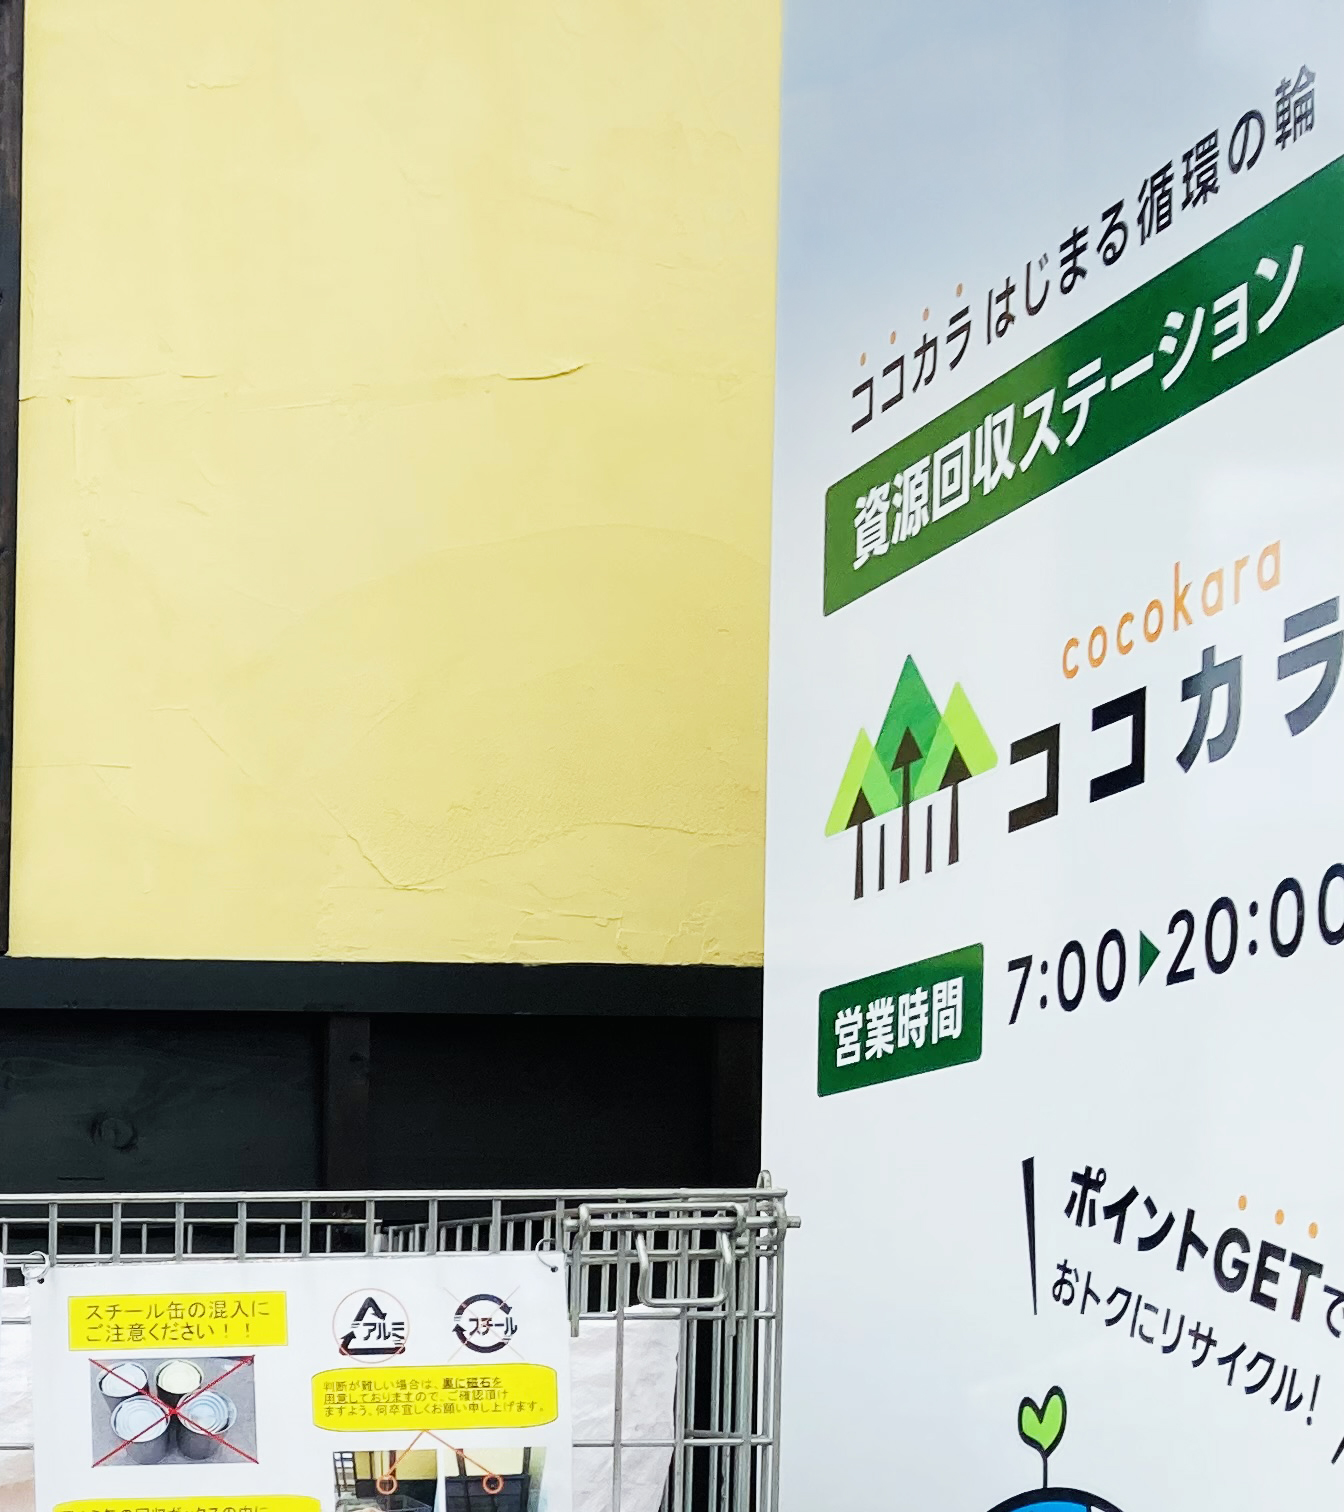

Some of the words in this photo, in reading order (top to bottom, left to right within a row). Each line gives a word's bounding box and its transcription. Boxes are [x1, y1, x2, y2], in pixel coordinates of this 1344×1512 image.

[851, 65, 1316, 433] ココカラはじまる循環の輪
[852, 244, 1304, 570] 資源回収ステーション
[1062, 540, 1281, 679] cocokara
[1008, 595, 1344, 833] ココカラ
[1007, 928, 1127, 1025] 7:00
[1166, 863, 1344, 986] 20:00
[834, 976, 965, 1068] 営業時間
[85, 1300, 270, 1321] スチール缶の混入に
[363, 1322, 405, 1341] アルミ
[468, 1317, 518, 1336] スチール
